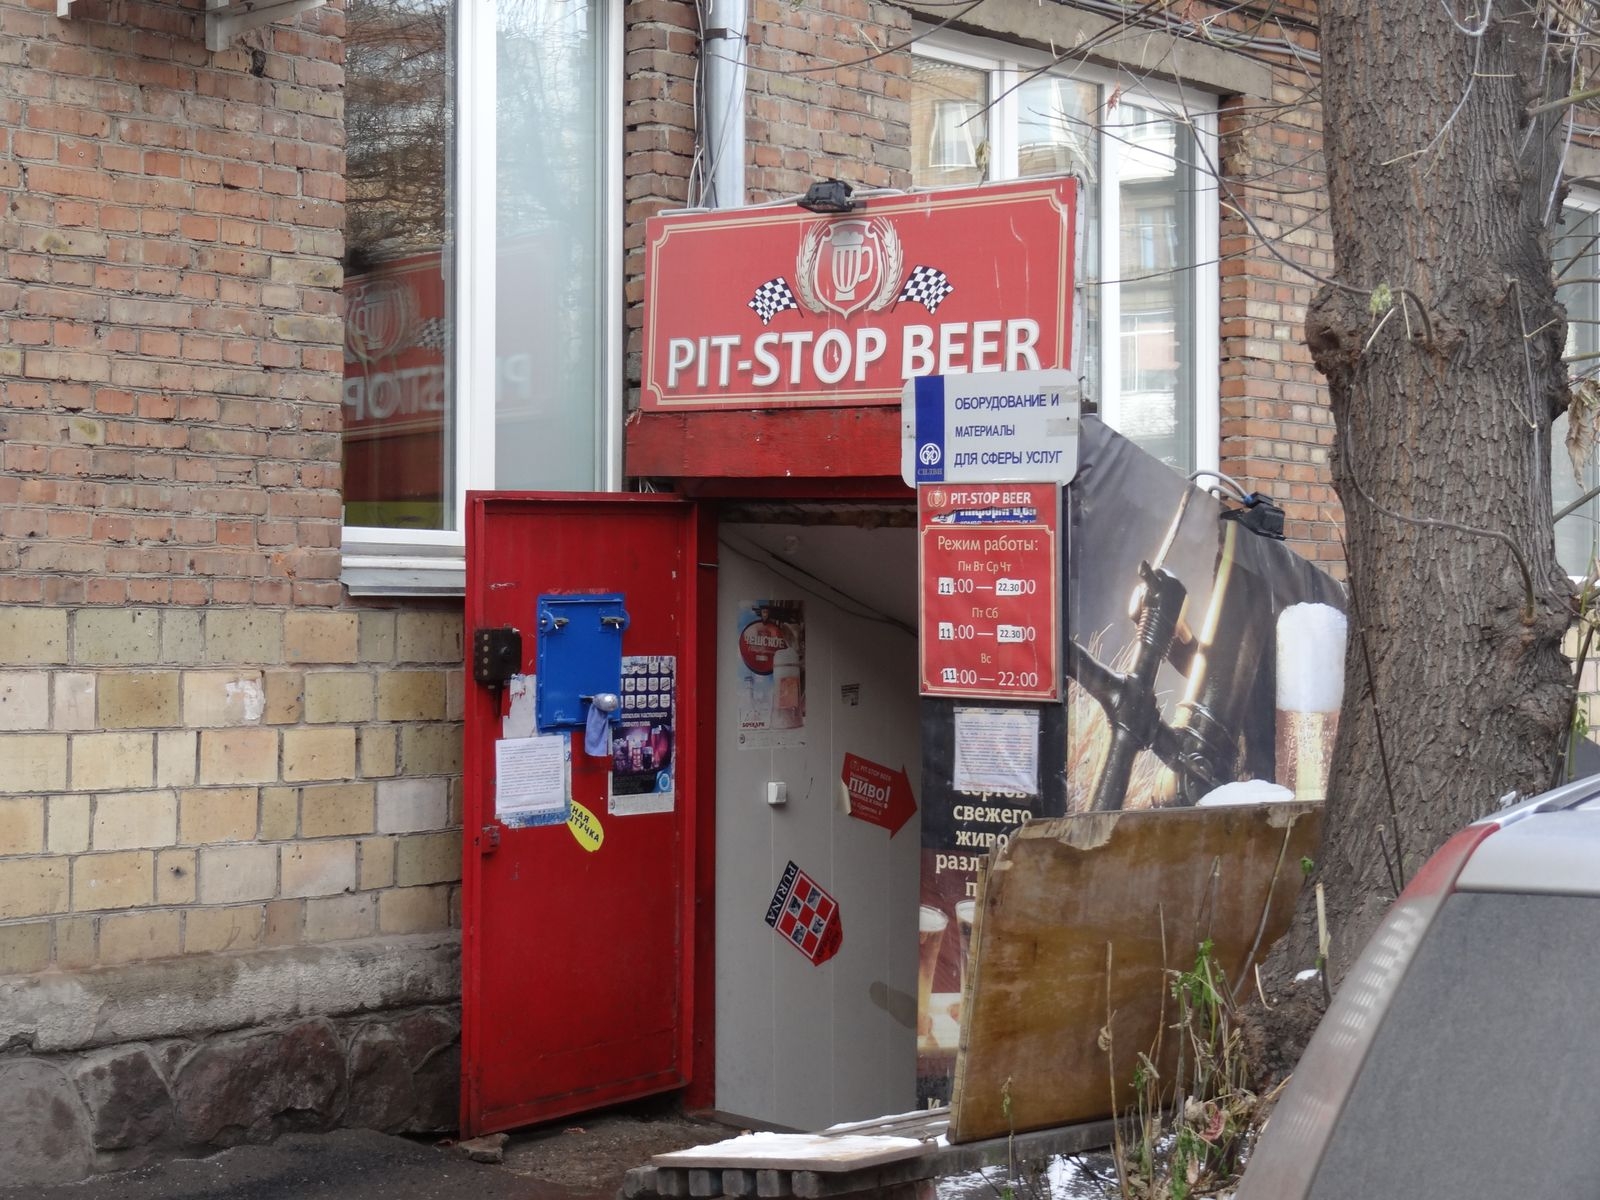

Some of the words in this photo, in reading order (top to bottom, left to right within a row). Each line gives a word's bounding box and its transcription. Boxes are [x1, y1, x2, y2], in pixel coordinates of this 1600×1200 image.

[667, 327, 887, 389] PIT-STOP
[901, 318, 1042, 381] BEER
[954, 393, 1047, 411] ОБОРУДОВАНИЕ
[1050, 393, 1060, 406] И
[955, 424, 1015, 438] МАТЕРИАЛЫ
[954, 452, 978, 468] ДЛЯ
[981, 451, 1022, 466] СФЕРЫ
[1026, 450, 1063, 465] УСЛУГ
[950, 492, 1000, 505] PIT-STOP
[1002, 491, 1031, 504] BEER
[937, 535, 981, 551] Режим
[984, 534, 1039, 555] работы:
[958, 560, 972, 571] Пн
[973, 560, 985, 571] Вт
[986, 561, 999, 574] Ср
[1000, 560, 1012, 572] Чт
[971, 607, 984, 619] Пт
[985, 606, 999, 619] Сб
[980, 652, 992, 664] Вс
[998, 671, 1038, 687] 22:00
[849, 776, 891, 809] ПИВО!
[570, 803, 590, 824] НАЯ
[952, 804, 1032, 824] свежего
[935, 853, 980, 874] разл
[767, 863, 797, 923] PURINA
